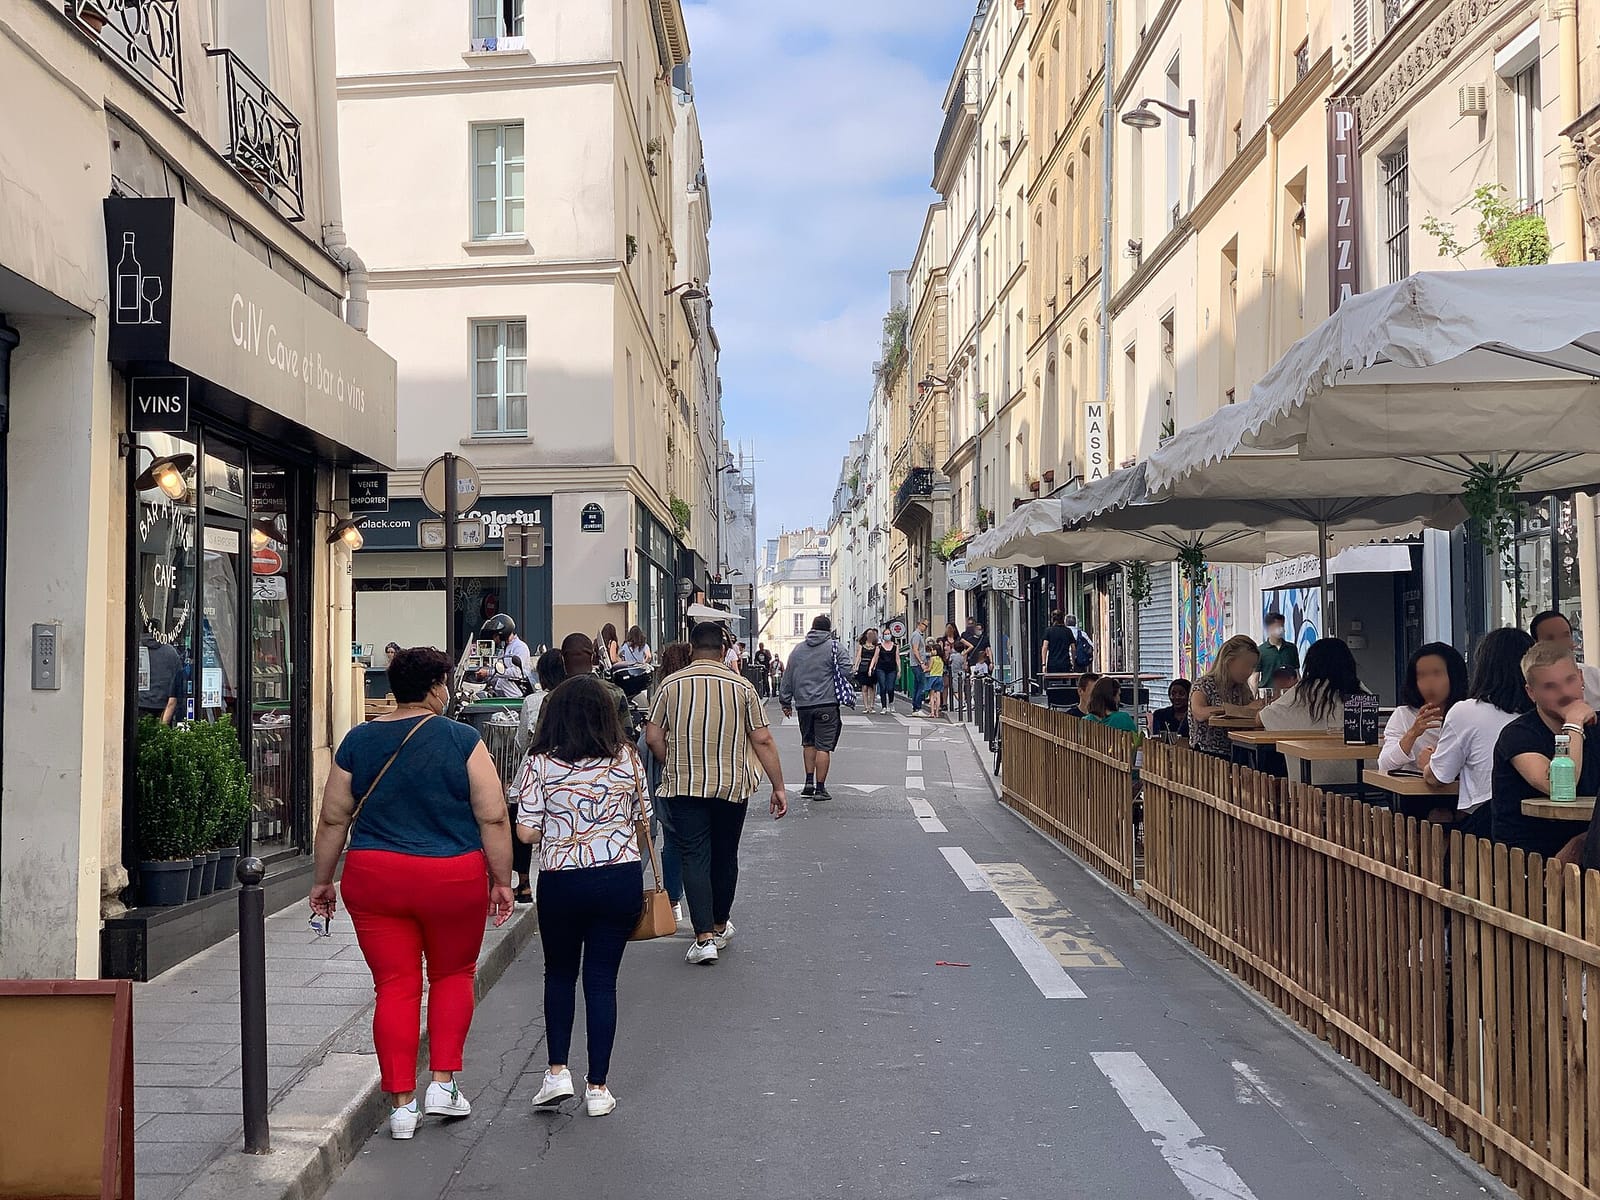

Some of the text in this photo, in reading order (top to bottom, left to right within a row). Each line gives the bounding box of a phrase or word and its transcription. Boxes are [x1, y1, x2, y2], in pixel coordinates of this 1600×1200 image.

[230, 292, 365, 413] G.IV Cave et Bar à vins
[138, 395, 181, 413] VINS
[1088, 405, 1102, 480] MASSA
[357, 480, 379, 488] VENTE
[351, 496, 386, 505] EMPORTER
[139, 501, 159, 543] BAR
[171, 501, 189, 552] VINS
[153, 563, 177, 589] CAVE
[998, 567, 1017, 575] SAUF
[610, 580, 631, 588] SAUF
[152, 630, 168, 645] FOOD
